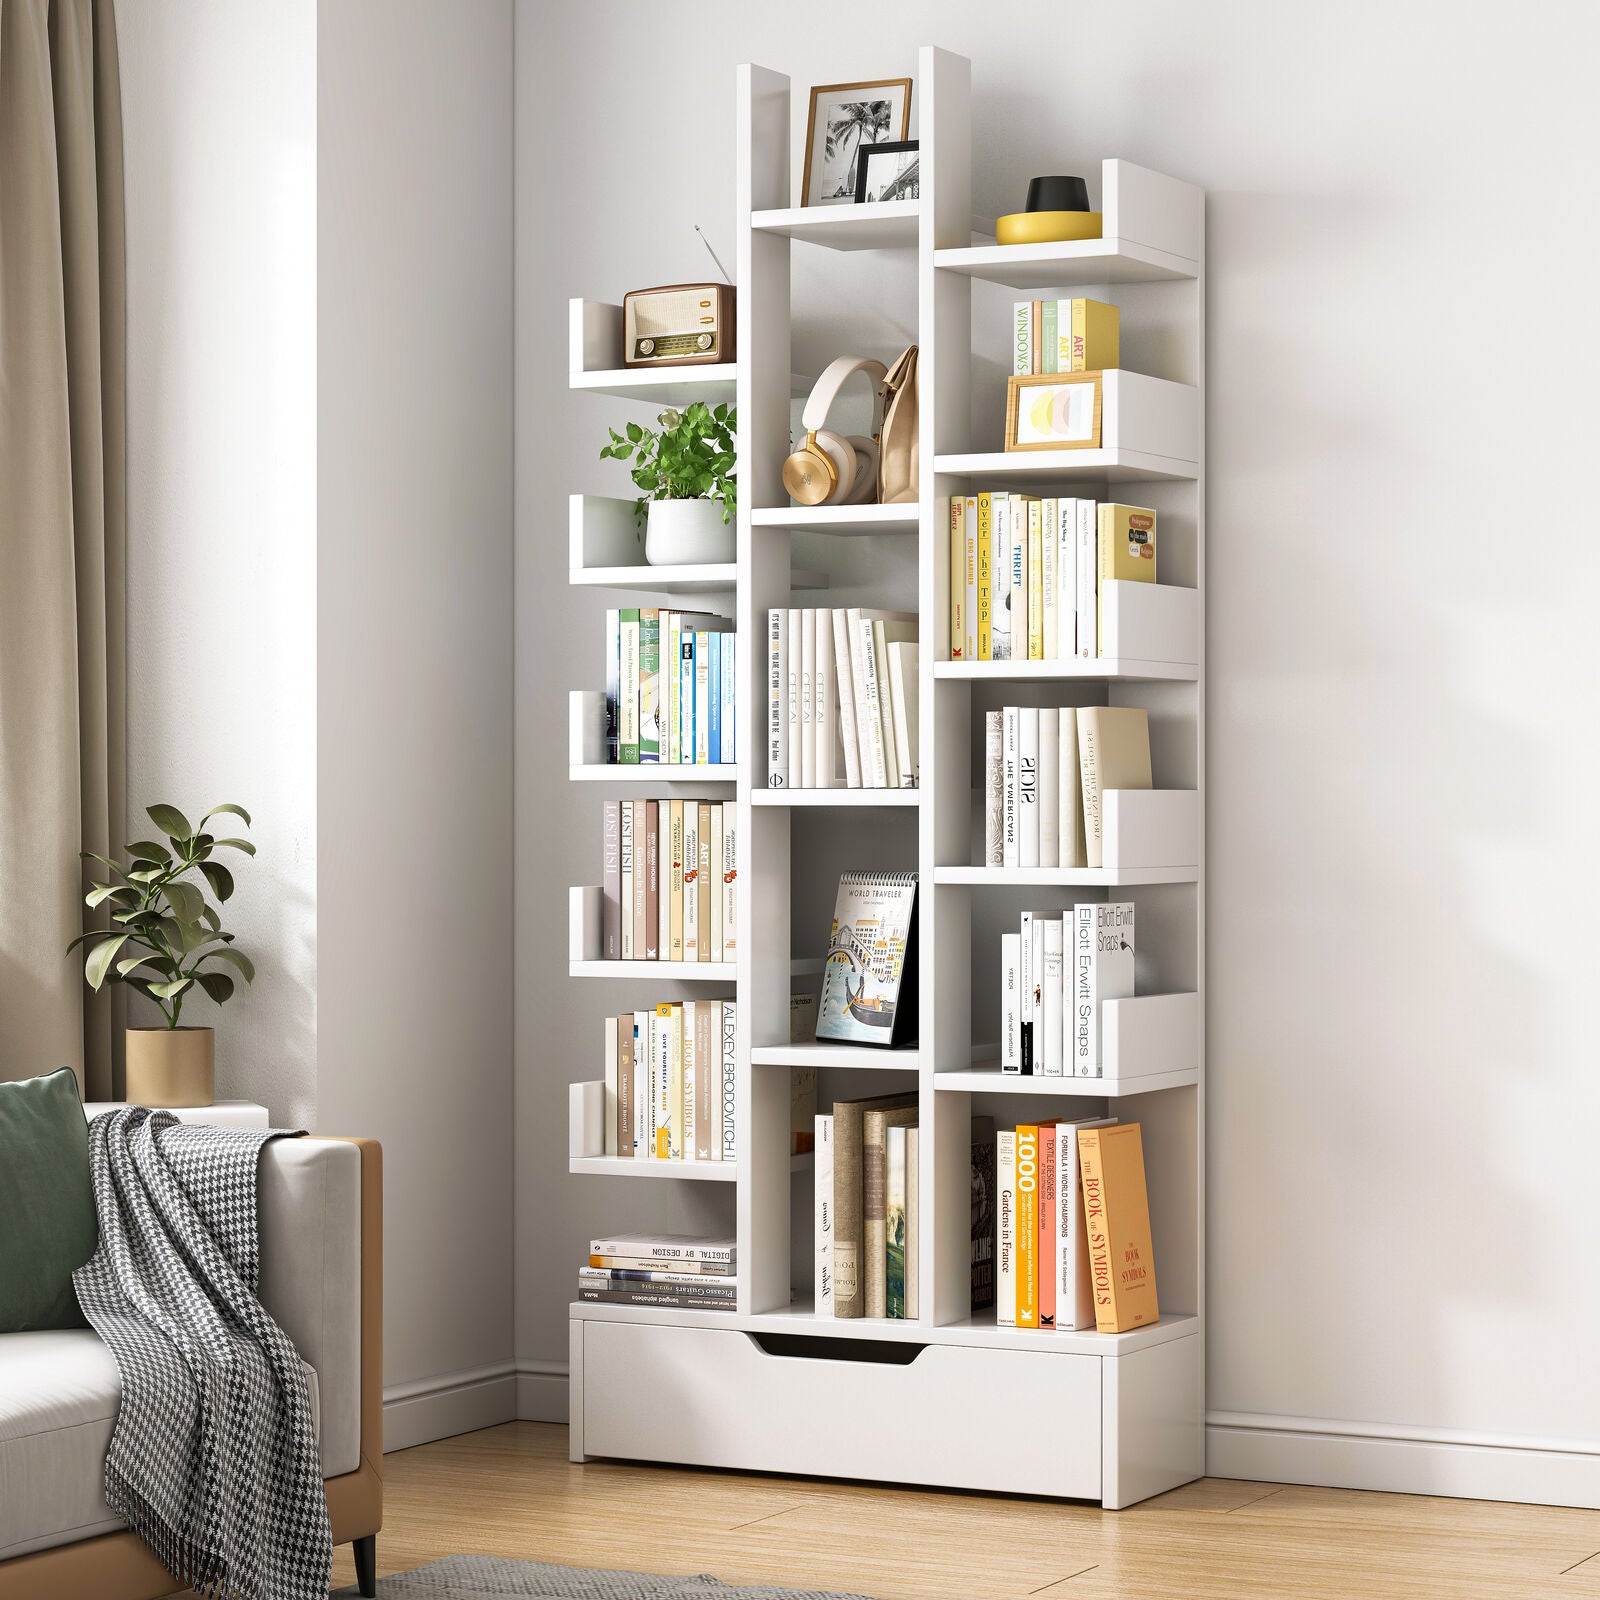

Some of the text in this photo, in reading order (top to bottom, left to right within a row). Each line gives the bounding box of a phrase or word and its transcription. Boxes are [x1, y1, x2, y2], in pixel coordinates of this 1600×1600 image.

[1017, 306, 1028, 370] WINDOWS
[1060, 336, 1069, 360] ART
[1074, 336, 1084, 359] ART
[980, 498, 989, 538] Over
[645, 612, 654, 628] The
[607, 805, 617, 873] LOST FISH
[623, 807, 632, 873] LOST FISH
[700, 842, 708, 867] ART
[1098, 906, 1133, 928] Elliott Erwitt
[1098, 931, 1118, 955] Snaps
[1078, 908, 1091, 1057] Elliott Erwitt Snaps
[684, 1039, 693, 1138] BOOK SYMBOLS
[724, 1006, 735, 1150] ALEXEY BRODOVITCH
[1018, 1132, 1036, 1192] 1000
[1086, 1178, 1102, 1218] BOOK
[1002, 1190, 1012, 1273] Gardens in France
[652, 1248, 681, 1257] DESIGN
[700, 1251, 730, 1260] DIGITAL
[1125, 1248, 1139, 1262] BOOK
[1091, 1234, 1111, 1305] SYMBOLS
[1122, 1266, 1146, 1283] SYMBOLS
[676, 1286, 733, 1297] Picasso Guitars
[1021, 1308, 1032, 1321] K
[1041, 1314, 1054, 1324] K
